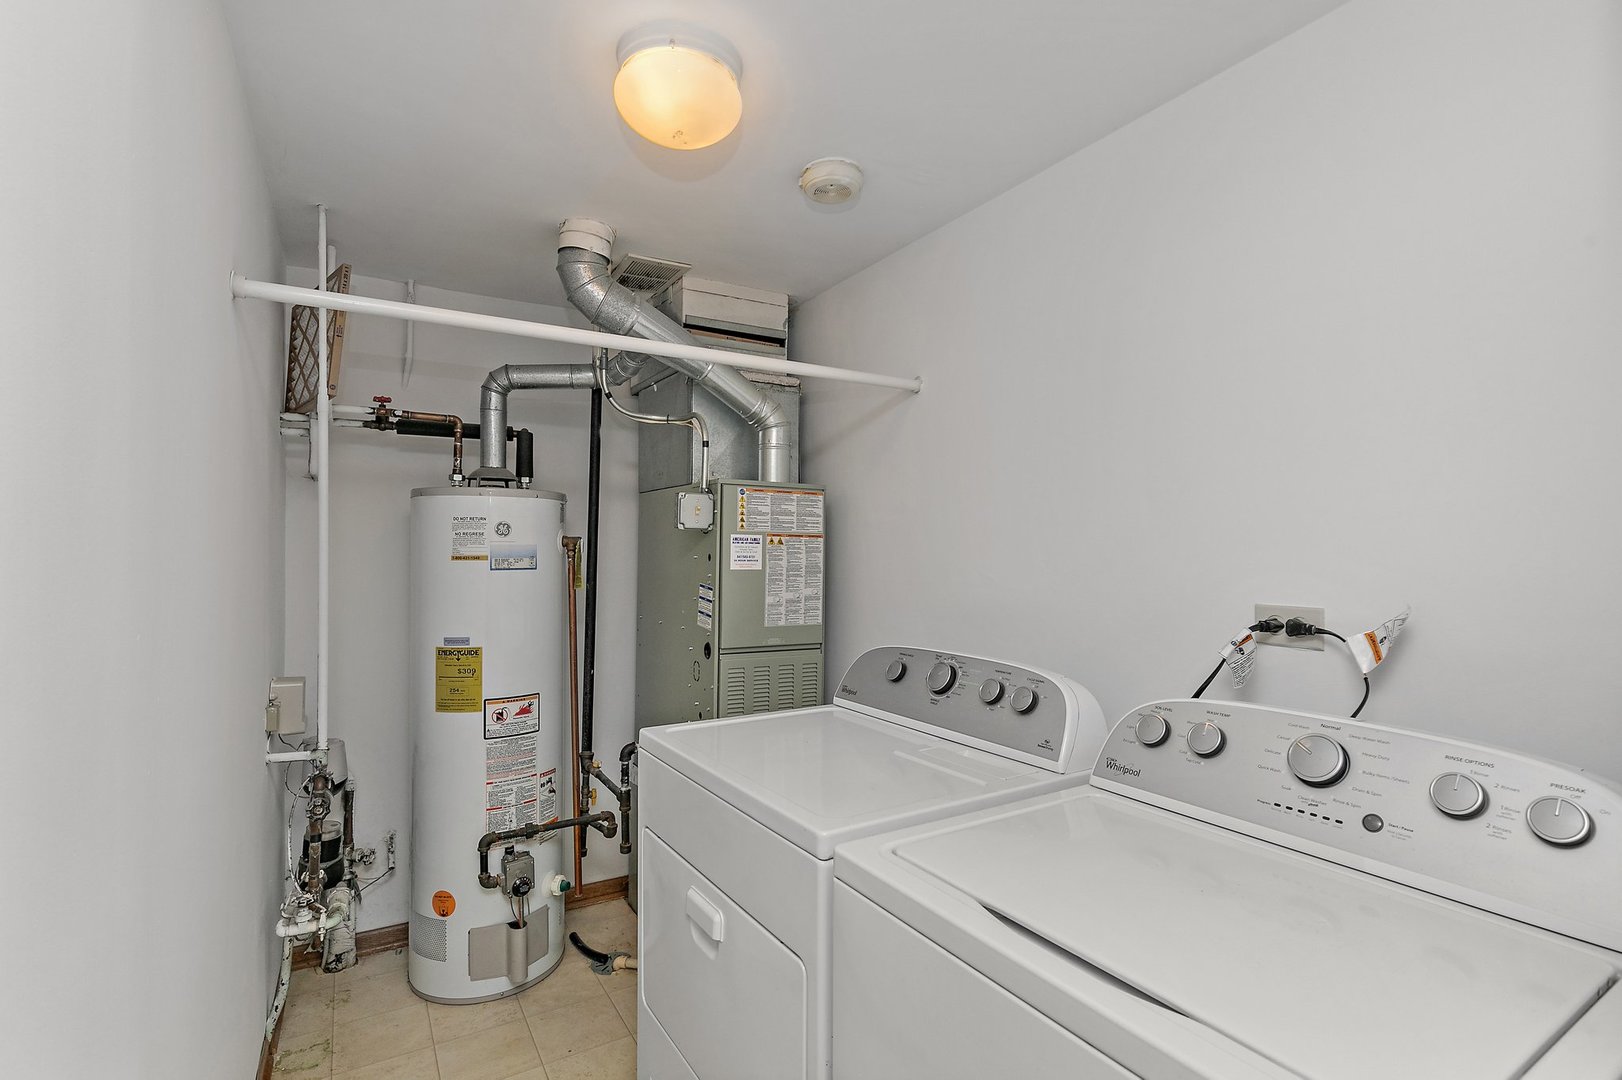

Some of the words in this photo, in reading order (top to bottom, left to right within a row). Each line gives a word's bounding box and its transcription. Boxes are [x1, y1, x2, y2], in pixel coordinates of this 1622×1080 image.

[1106, 760, 1141, 777] Whirlpool
[1465, 758, 1494, 769] OPTIONS
[1550, 783, 1586, 794] PRESOAK
